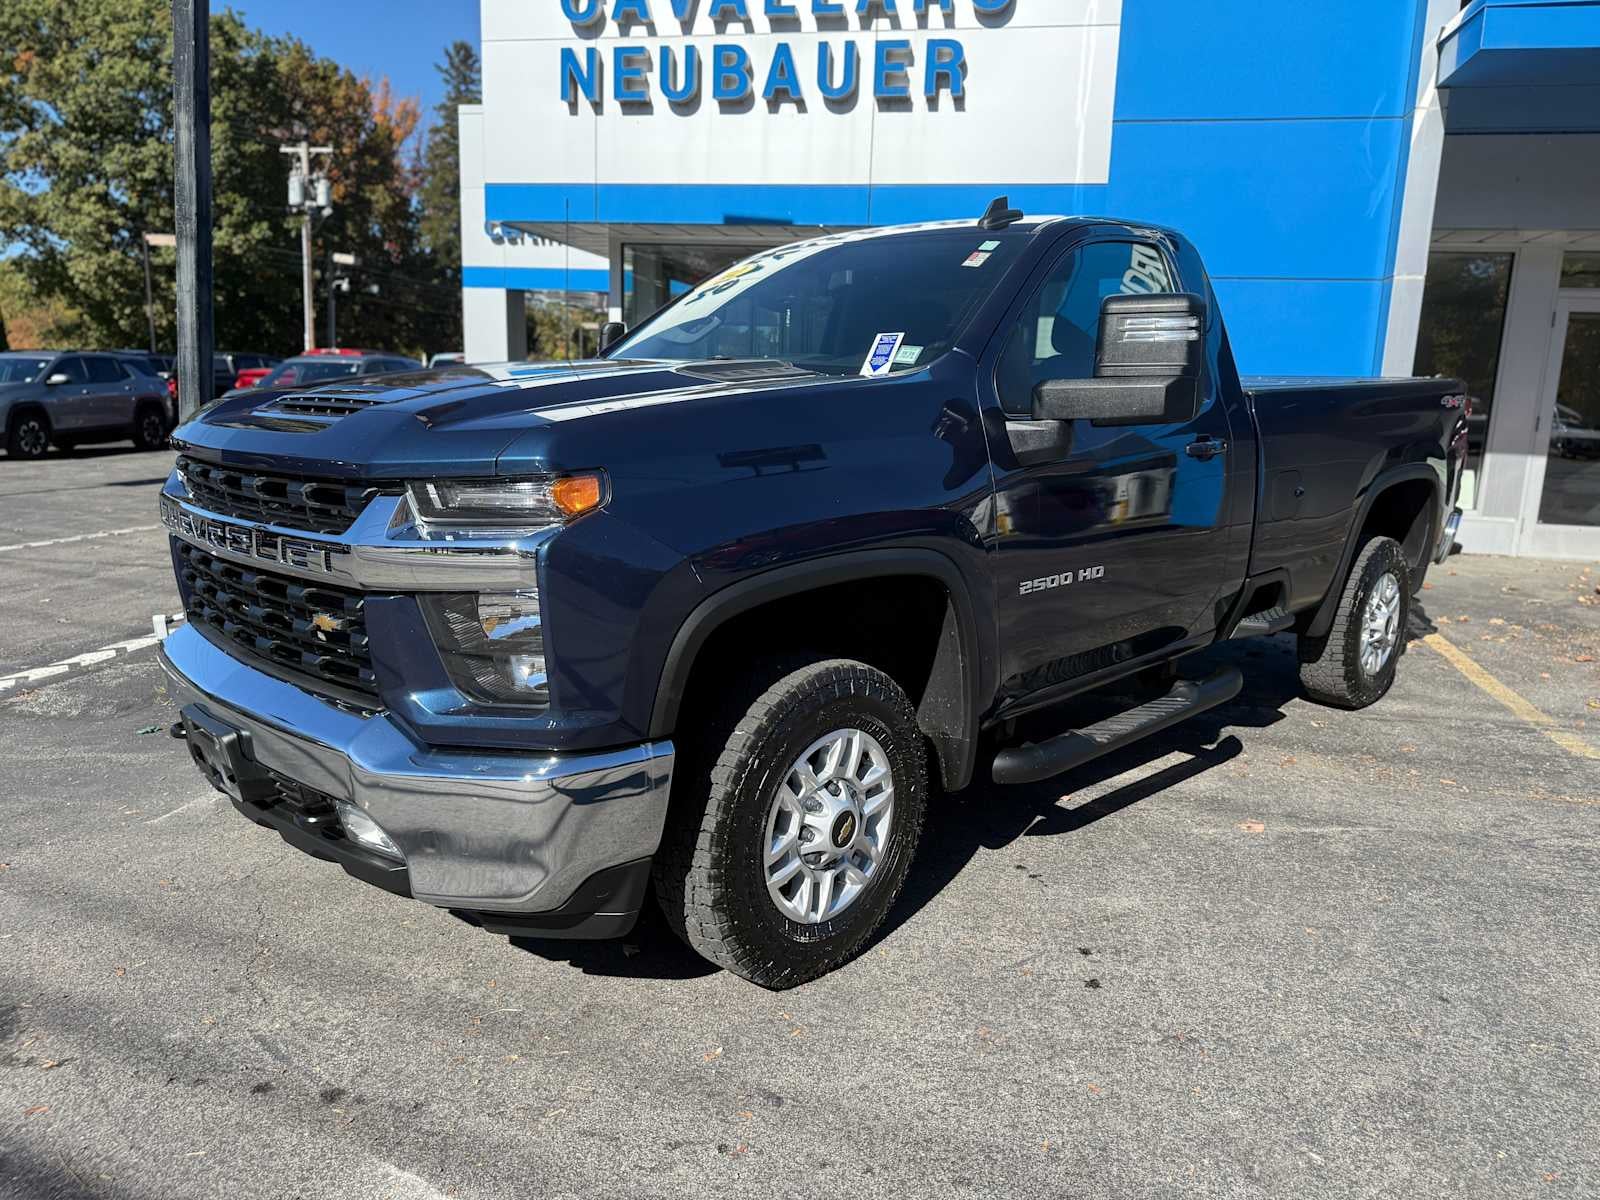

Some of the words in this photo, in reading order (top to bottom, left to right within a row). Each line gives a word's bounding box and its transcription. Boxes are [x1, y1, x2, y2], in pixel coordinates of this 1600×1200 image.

[560, 38, 967, 103] NEUBAUER
[1019, 571, 1073, 595] 2500
[1078, 565, 1105, 582] HD
